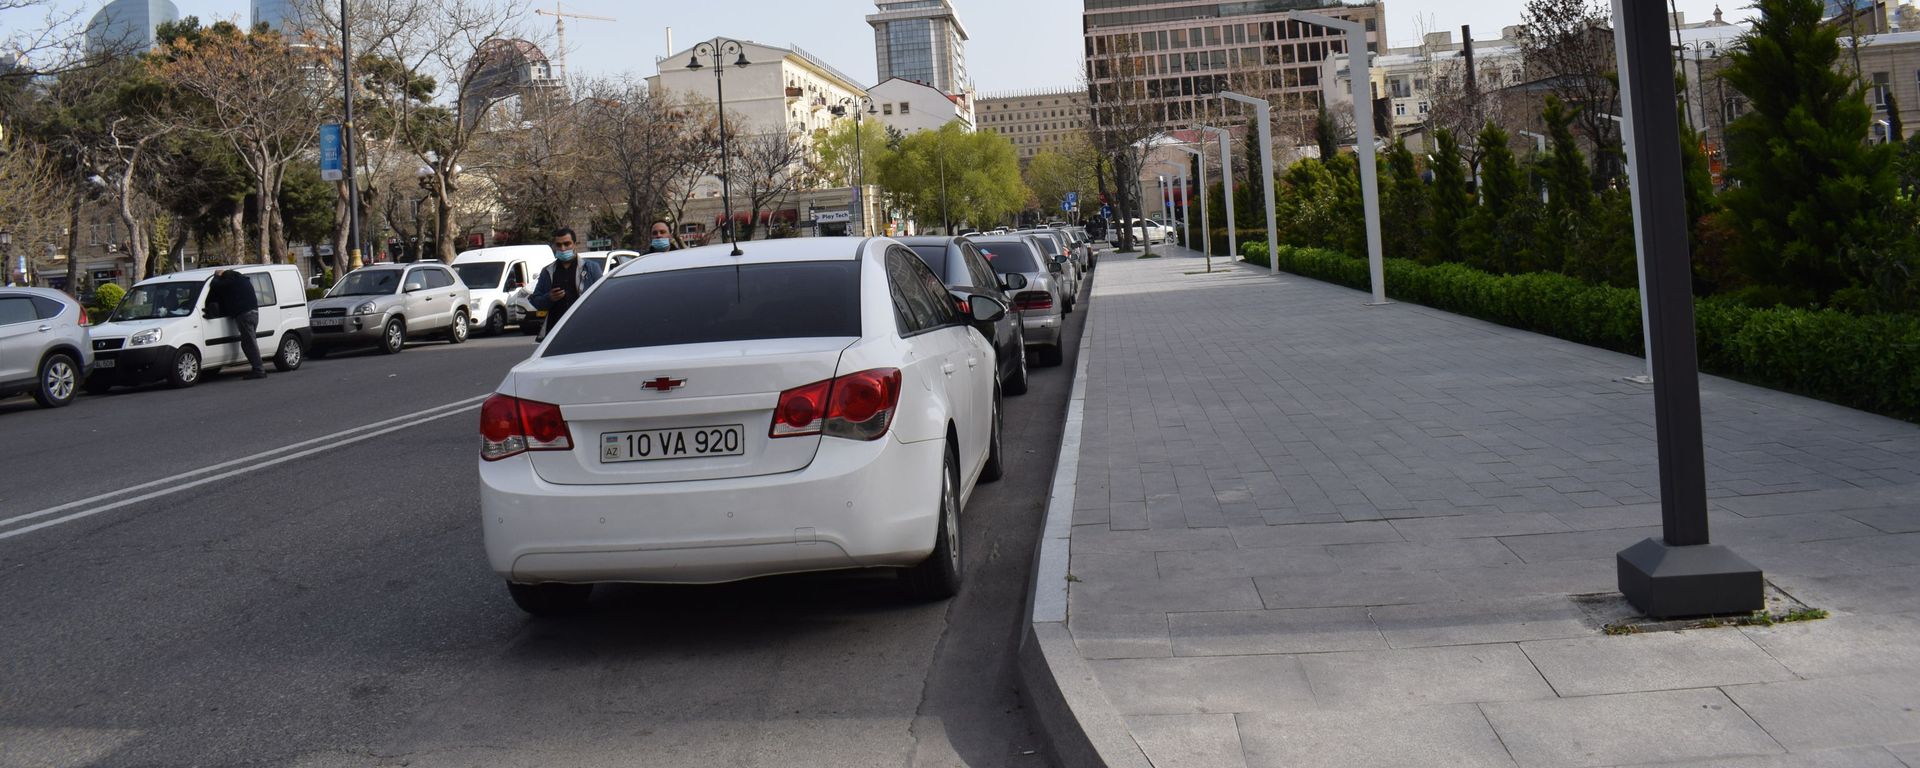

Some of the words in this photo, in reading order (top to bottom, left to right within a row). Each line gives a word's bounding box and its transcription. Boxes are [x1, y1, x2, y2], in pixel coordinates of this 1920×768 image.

[606, 447, 618, 456] AZ
[626, 434, 651, 458] 10
[659, 431, 687, 456] VA
[695, 428, 739, 454] 920
